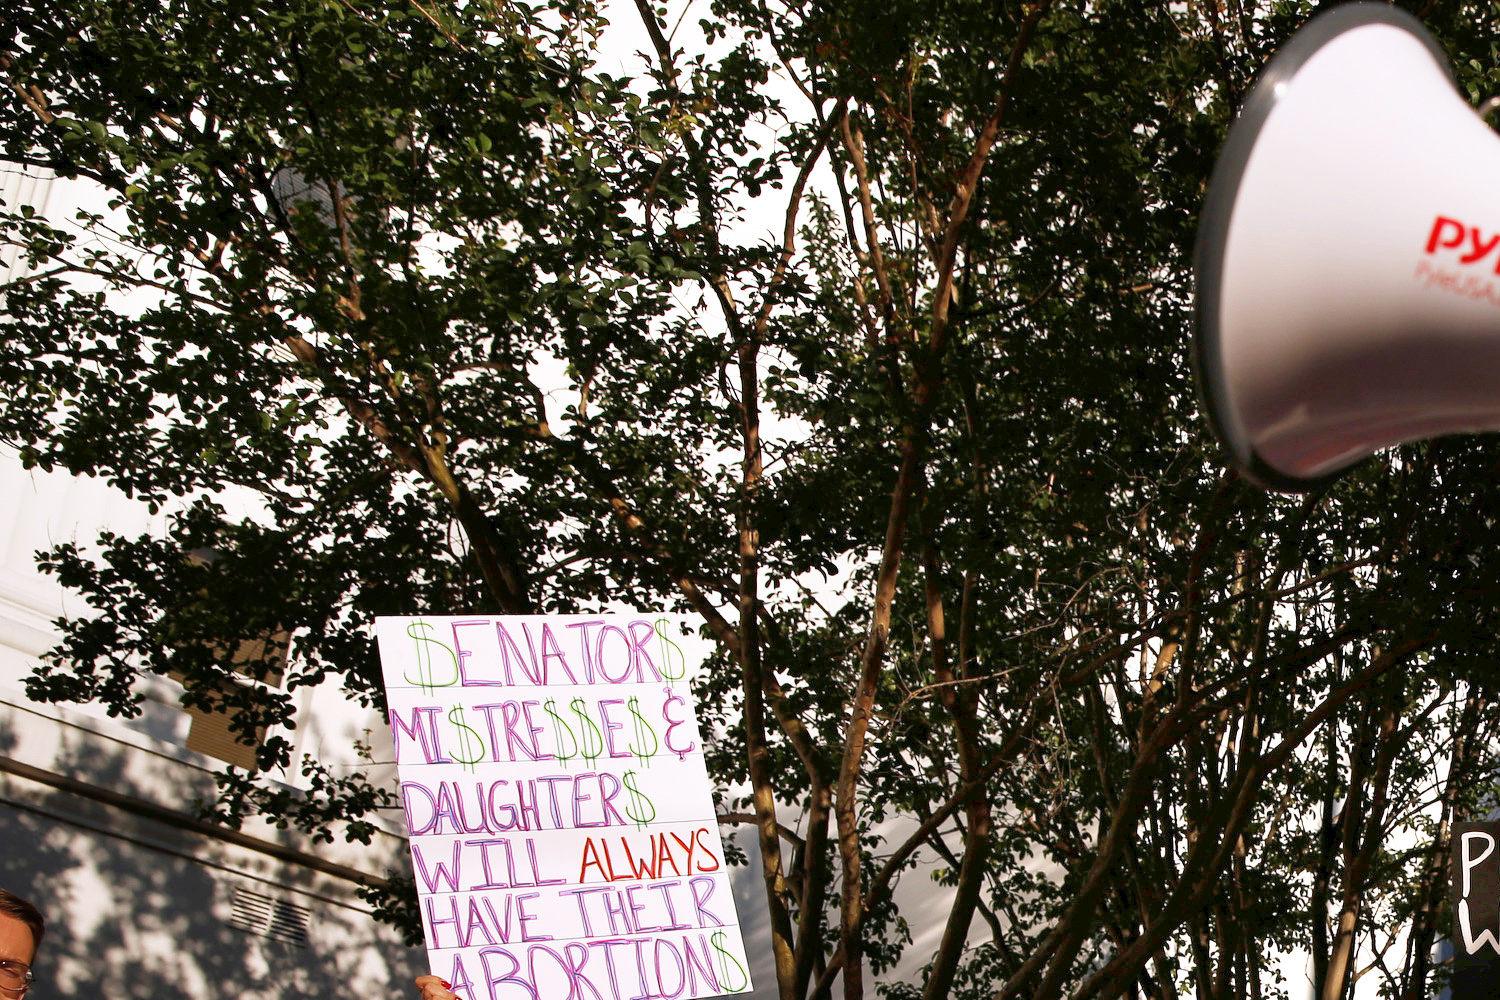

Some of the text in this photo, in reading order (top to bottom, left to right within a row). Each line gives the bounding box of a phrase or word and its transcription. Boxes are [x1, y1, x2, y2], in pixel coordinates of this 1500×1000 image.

[663, 686, 697, 762] &
[411, 827, 720, 894] WILL ALWAYS
[424, 876, 726, 950] HAVE THEIR
